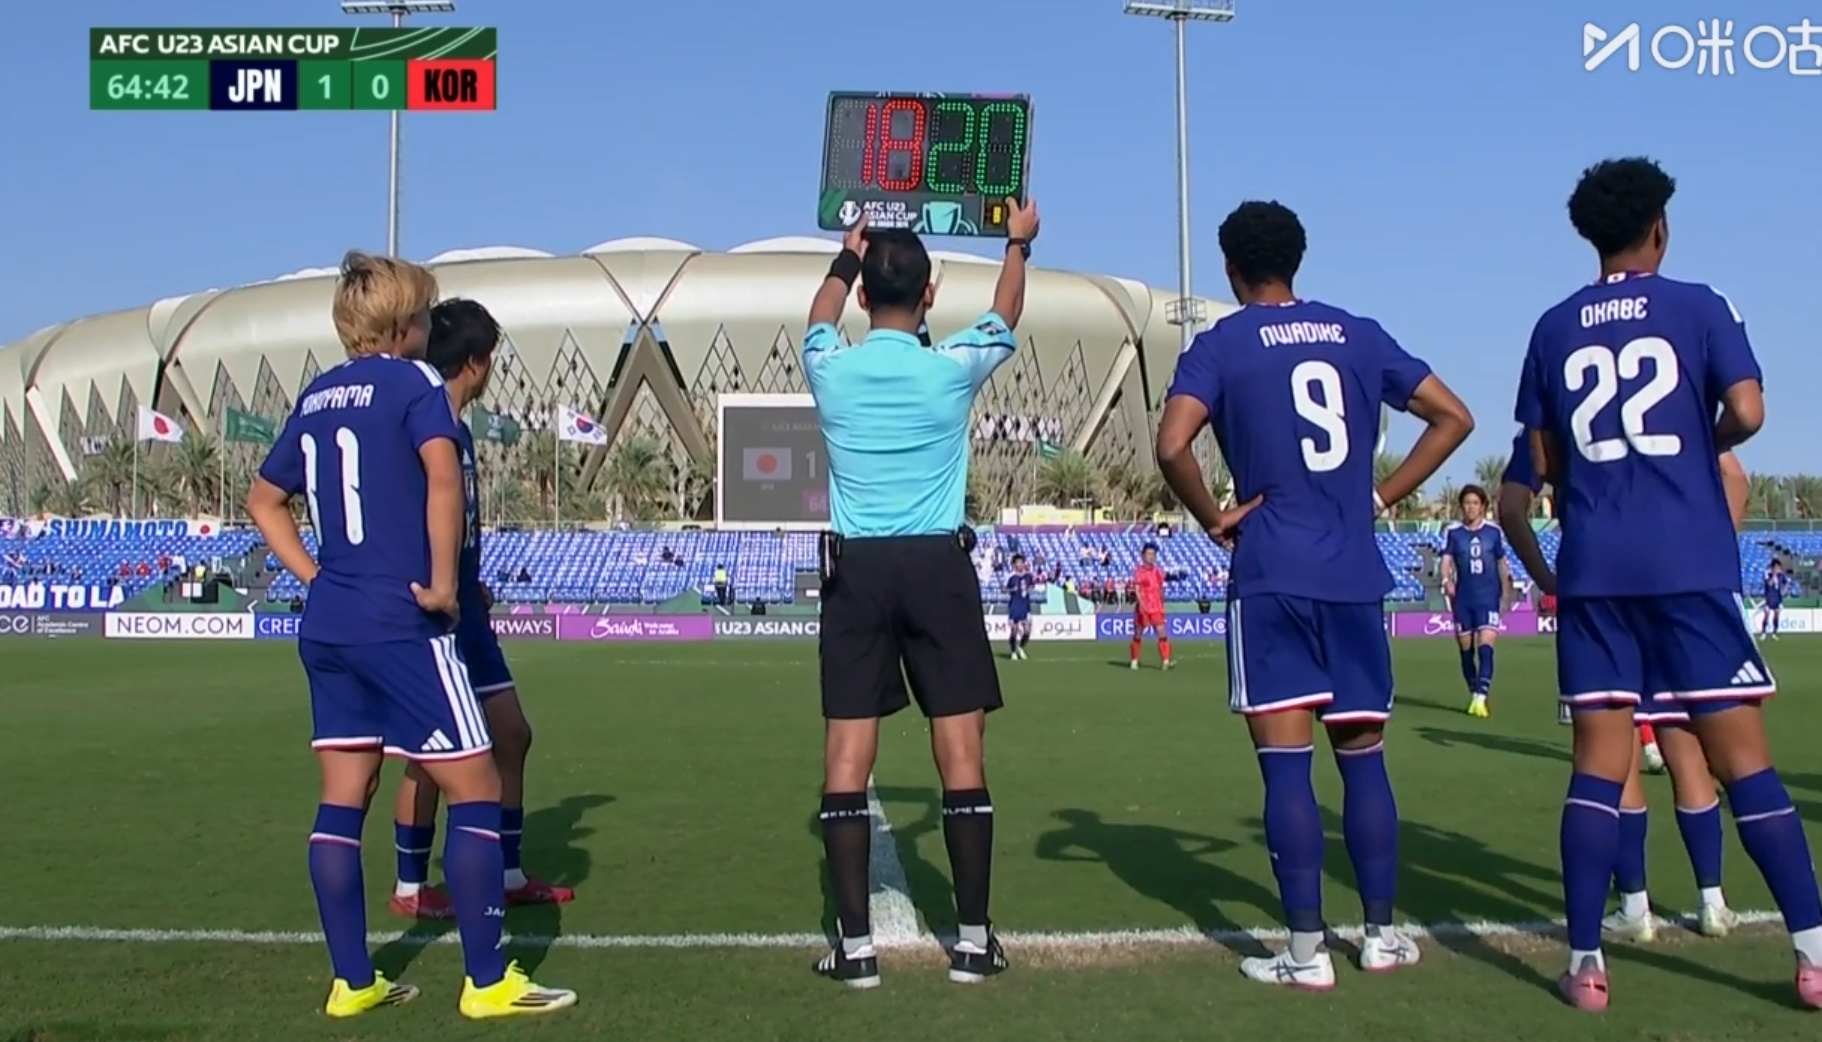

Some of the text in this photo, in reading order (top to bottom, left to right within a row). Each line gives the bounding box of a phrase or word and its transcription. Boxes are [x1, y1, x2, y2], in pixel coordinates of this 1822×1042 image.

[863, 99, 1024, 194] 18 20
[863, 201, 906, 211] AFC U23
[896, 212, 917, 221] CUP
[1580, 297, 1648, 328] OKABE
[1259, 321, 1346, 347] NWADIKE
[1564, 336, 1681, 463] 22
[1291, 360, 1349, 472] 9
[806, 450, 816, 479] 1
[300, 426, 365, 547] 11
[50, 519, 188, 540] SHIMAMOTO
[1470, 559, 1483, 575] 19
[0, 585, 45, 608] OAD
[50, 585, 86, 608] TO
[117, 616, 243, 634] NEOM.COM
[490, 619, 553, 634] IRWAYS
[721, 621, 752, 635] U23
[754, 621, 803, 635] ASIAN
[1172, 617, 1227, 634] SAISO
